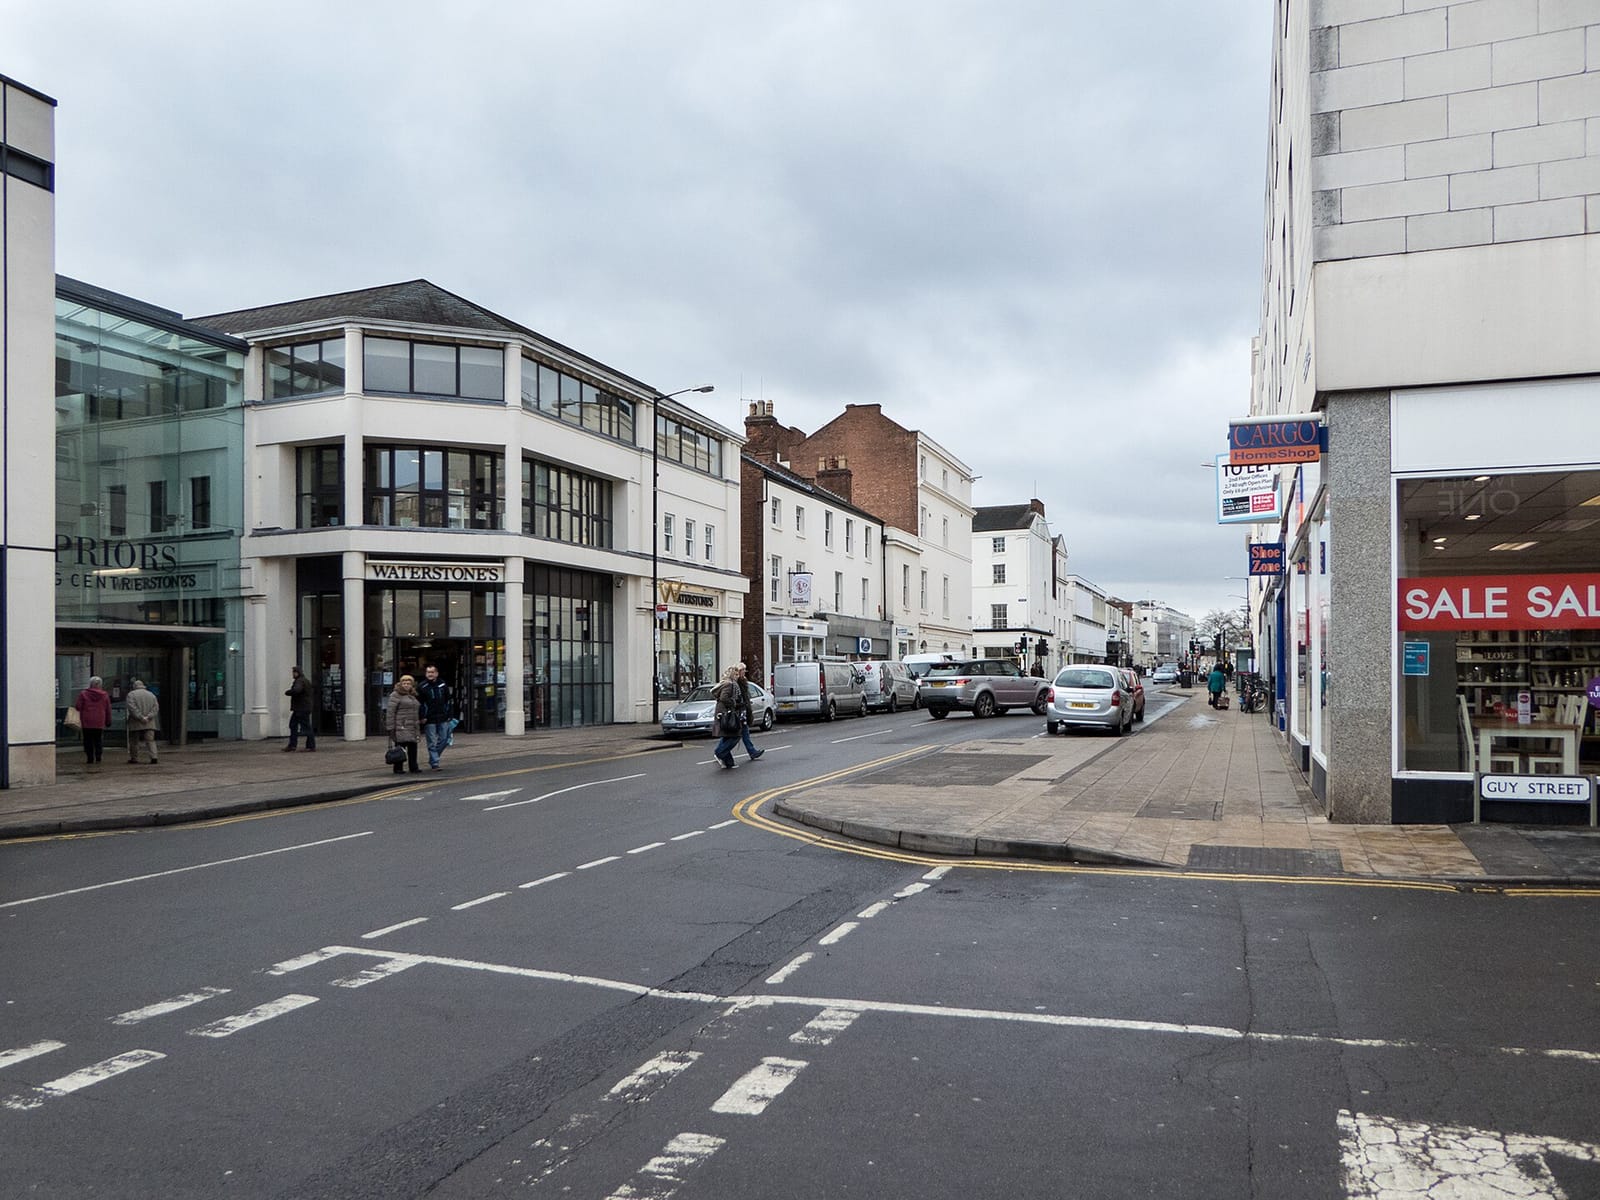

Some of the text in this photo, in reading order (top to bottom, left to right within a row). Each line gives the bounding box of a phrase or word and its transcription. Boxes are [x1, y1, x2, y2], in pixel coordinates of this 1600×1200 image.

[1234, 421, 1316, 447] CARGO
[1234, 449, 1316, 460] HomeShop
[1222, 464, 1242, 477] TO
[55, 534, 176, 573] PRIORS
[1251, 546, 1280, 558] Shoe
[372, 565, 499, 580] WATERSTONE'S
[1251, 560, 1280, 572] Zone
[1405, 587, 1508, 620] SALE
[1487, 782, 1584, 795] GUY STREET
